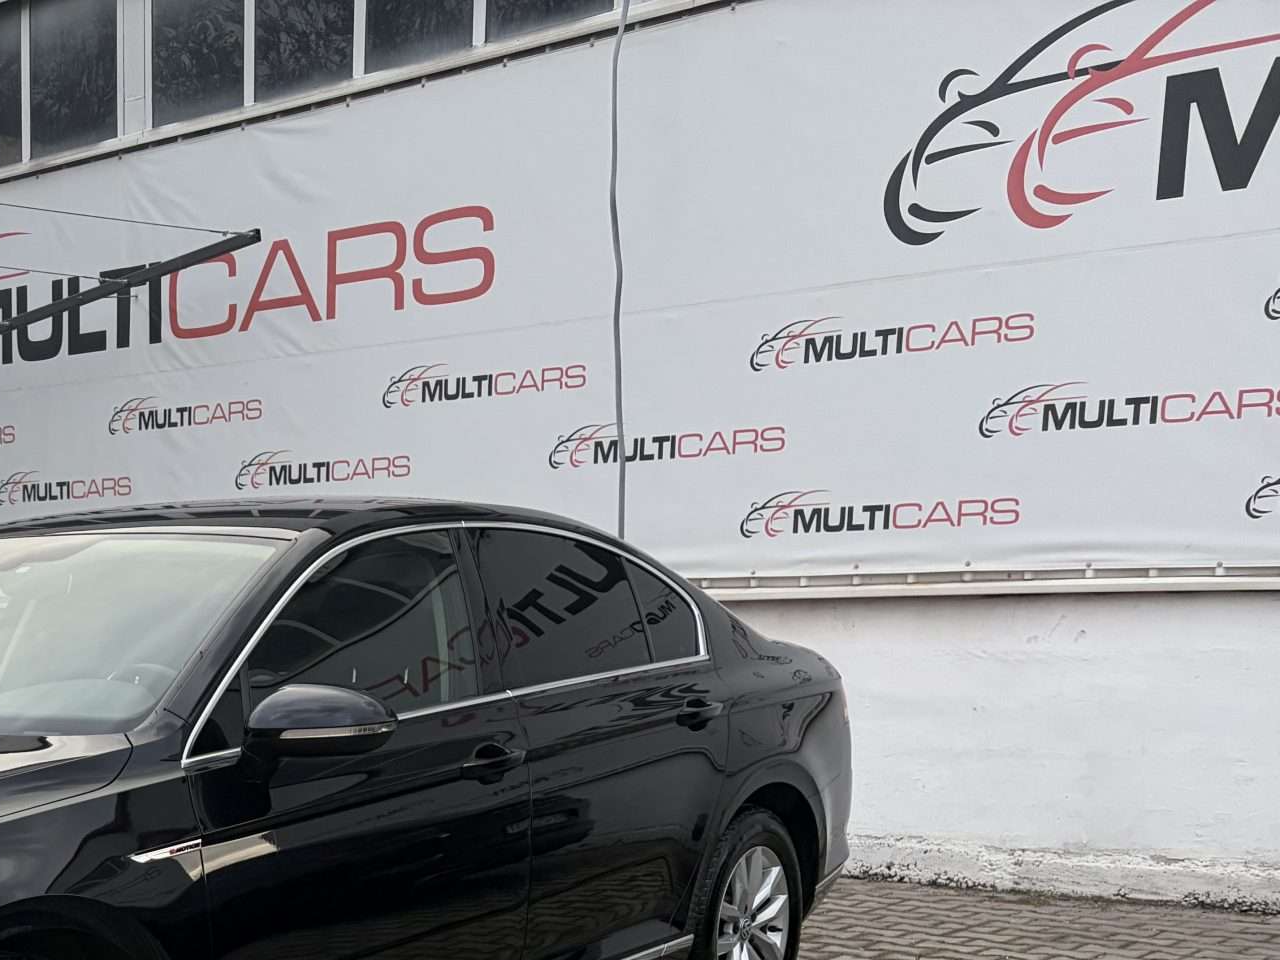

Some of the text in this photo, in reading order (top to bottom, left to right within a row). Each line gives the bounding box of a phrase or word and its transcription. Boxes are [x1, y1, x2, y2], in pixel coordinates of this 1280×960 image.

[803, 313, 1035, 364] MULTICARS
[421, 364, 587, 403] MULTICARS
[138, 399, 263, 431] MULTICARS
[1041, 388, 1280, 431] MULTICAR
[593, 426, 786, 464] MULTICARS
[22, 476, 132, 502] MULTICARS
[268, 455, 410, 486] MULTICARS
[792, 498, 1020, 534] MULTICARS
